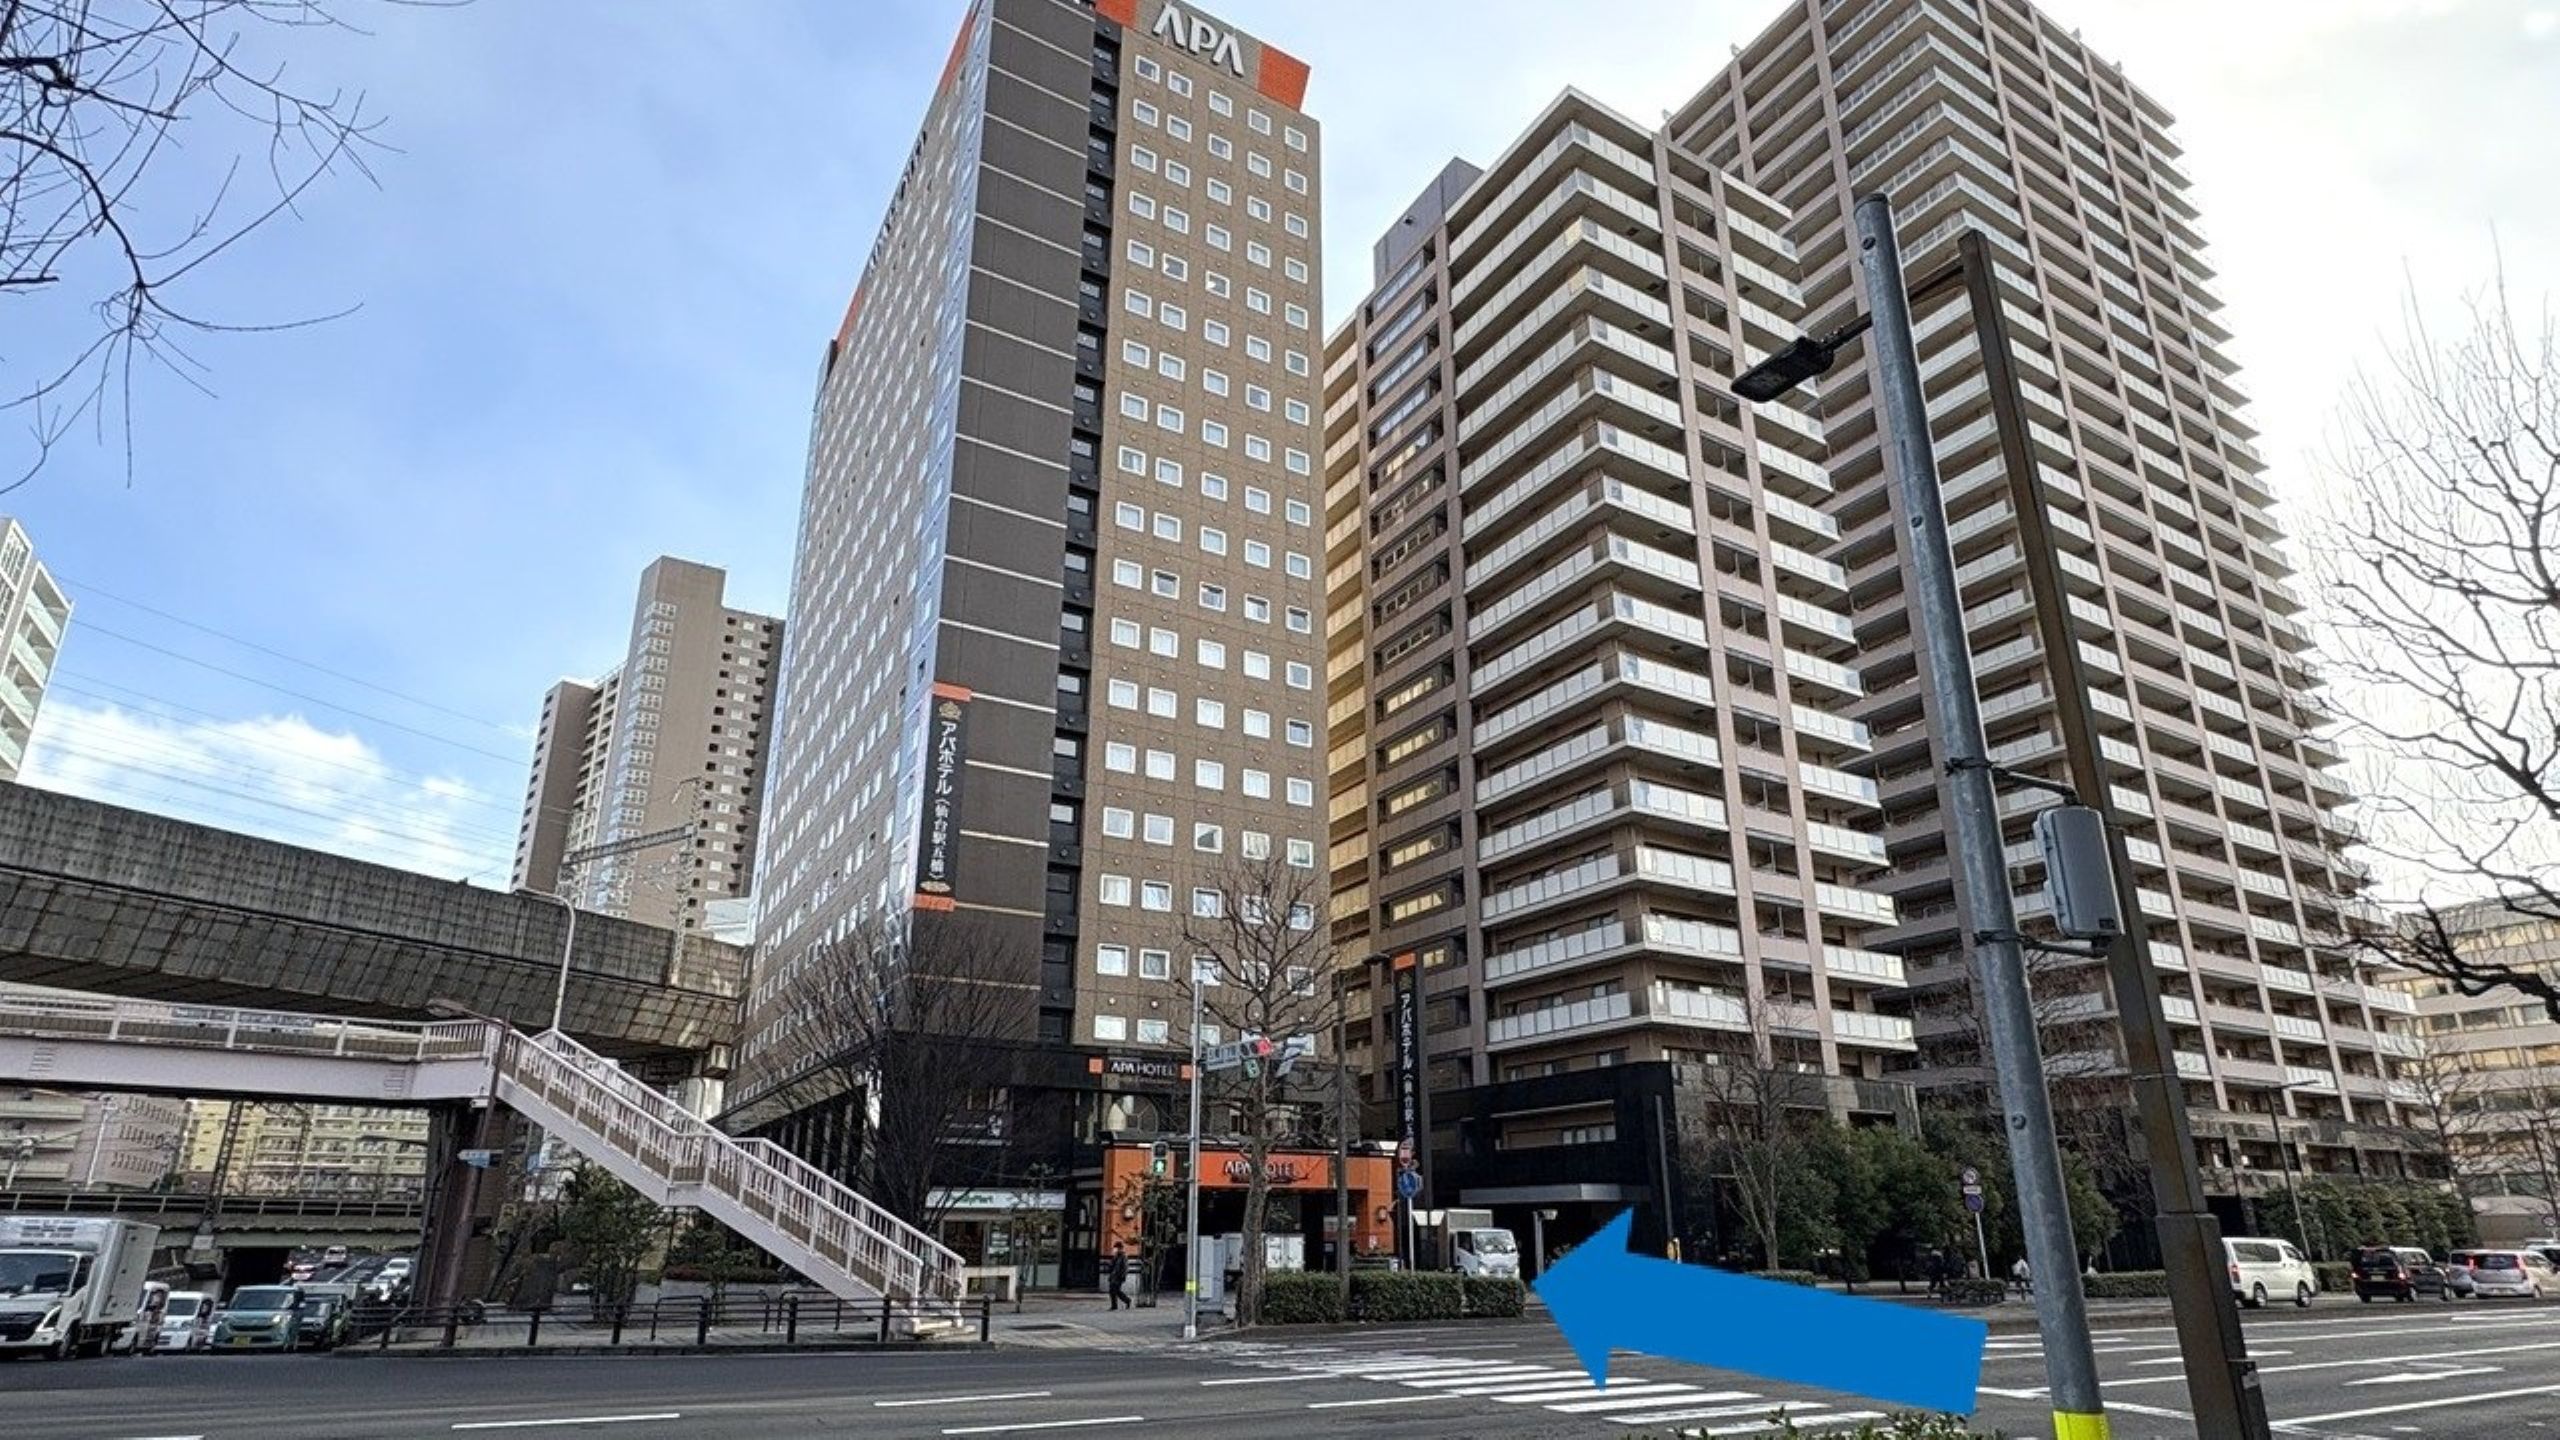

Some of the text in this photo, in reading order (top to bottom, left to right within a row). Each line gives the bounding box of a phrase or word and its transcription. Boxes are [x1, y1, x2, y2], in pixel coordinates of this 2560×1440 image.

[1152, 3, 1244, 76] APA
[1111, 1061, 1176, 1076] APA HOTEL
